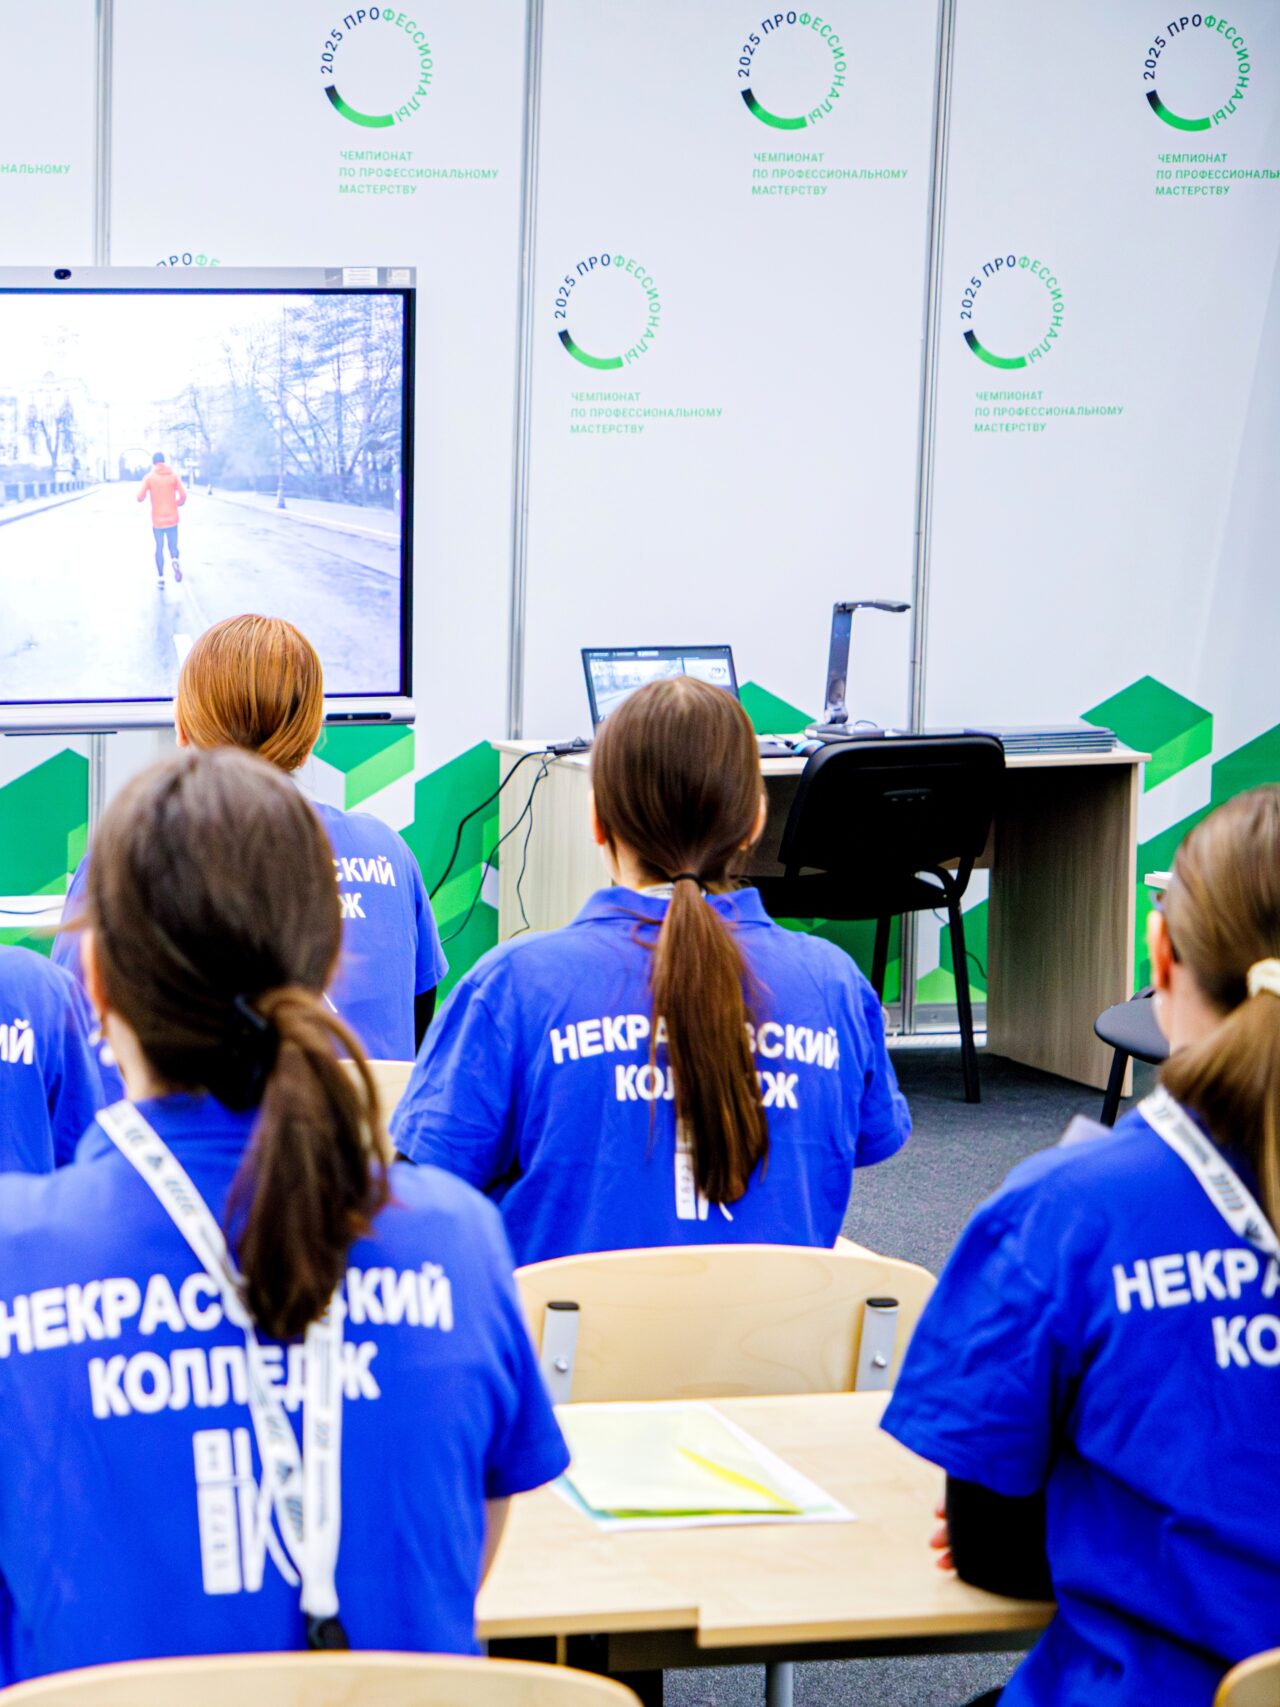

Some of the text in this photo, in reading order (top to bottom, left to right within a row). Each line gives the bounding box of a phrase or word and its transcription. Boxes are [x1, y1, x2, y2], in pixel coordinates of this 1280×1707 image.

[320, 7, 432, 122] 2025 ПРОФЕССИОНАЛЫ
[737, 11, 846, 124] 2025 ПРОФЕССИОНАЛЫ
[1143, 14, 1251, 125] 2025 ПРОФЕССИОНАЛЫ
[340, 151, 412, 161] ЧЕМПИОНАТ
[753, 152, 824, 163] ЧЕМПИОНАТ
[1157, 152, 1228, 163] ЧЕМПИОНАТ
[339, 167, 498, 179] ПО ПРОФЕССИОНАЛЬНОМУ
[752, 168, 908, 179] ПО ПРОФЕССИОНАЛЬНОМУ
[1156, 169, 1172, 179] ПО
[339, 183, 417, 194] МАСТЕРСТВУ
[752, 184, 827, 195] МАСТЕРСТВУ
[1155, 185, 1230, 195] МАСТЕРСТВУ
[554, 253, 660, 364] 2025 ПРОФЕССИОНАЛЫ
[960, 255, 1064, 363] 2025 ПРОФЕССИОНАЛЫ
[571, 391, 640, 402] ЧЕМПИОНАТ
[975, 391, 1043, 401] ЧЕМПИОНАТ
[570, 408, 722, 418] ПО ПРОФЕССИОНАЛЬНОМУ
[974, 406, 1124, 417] ПО ПРОФЕССИОНАЛЬНОМУ
[570, 424, 644, 434] МАСТЕРСТВУ
[974, 422, 1047, 433] МАСТЕРСТВУ
